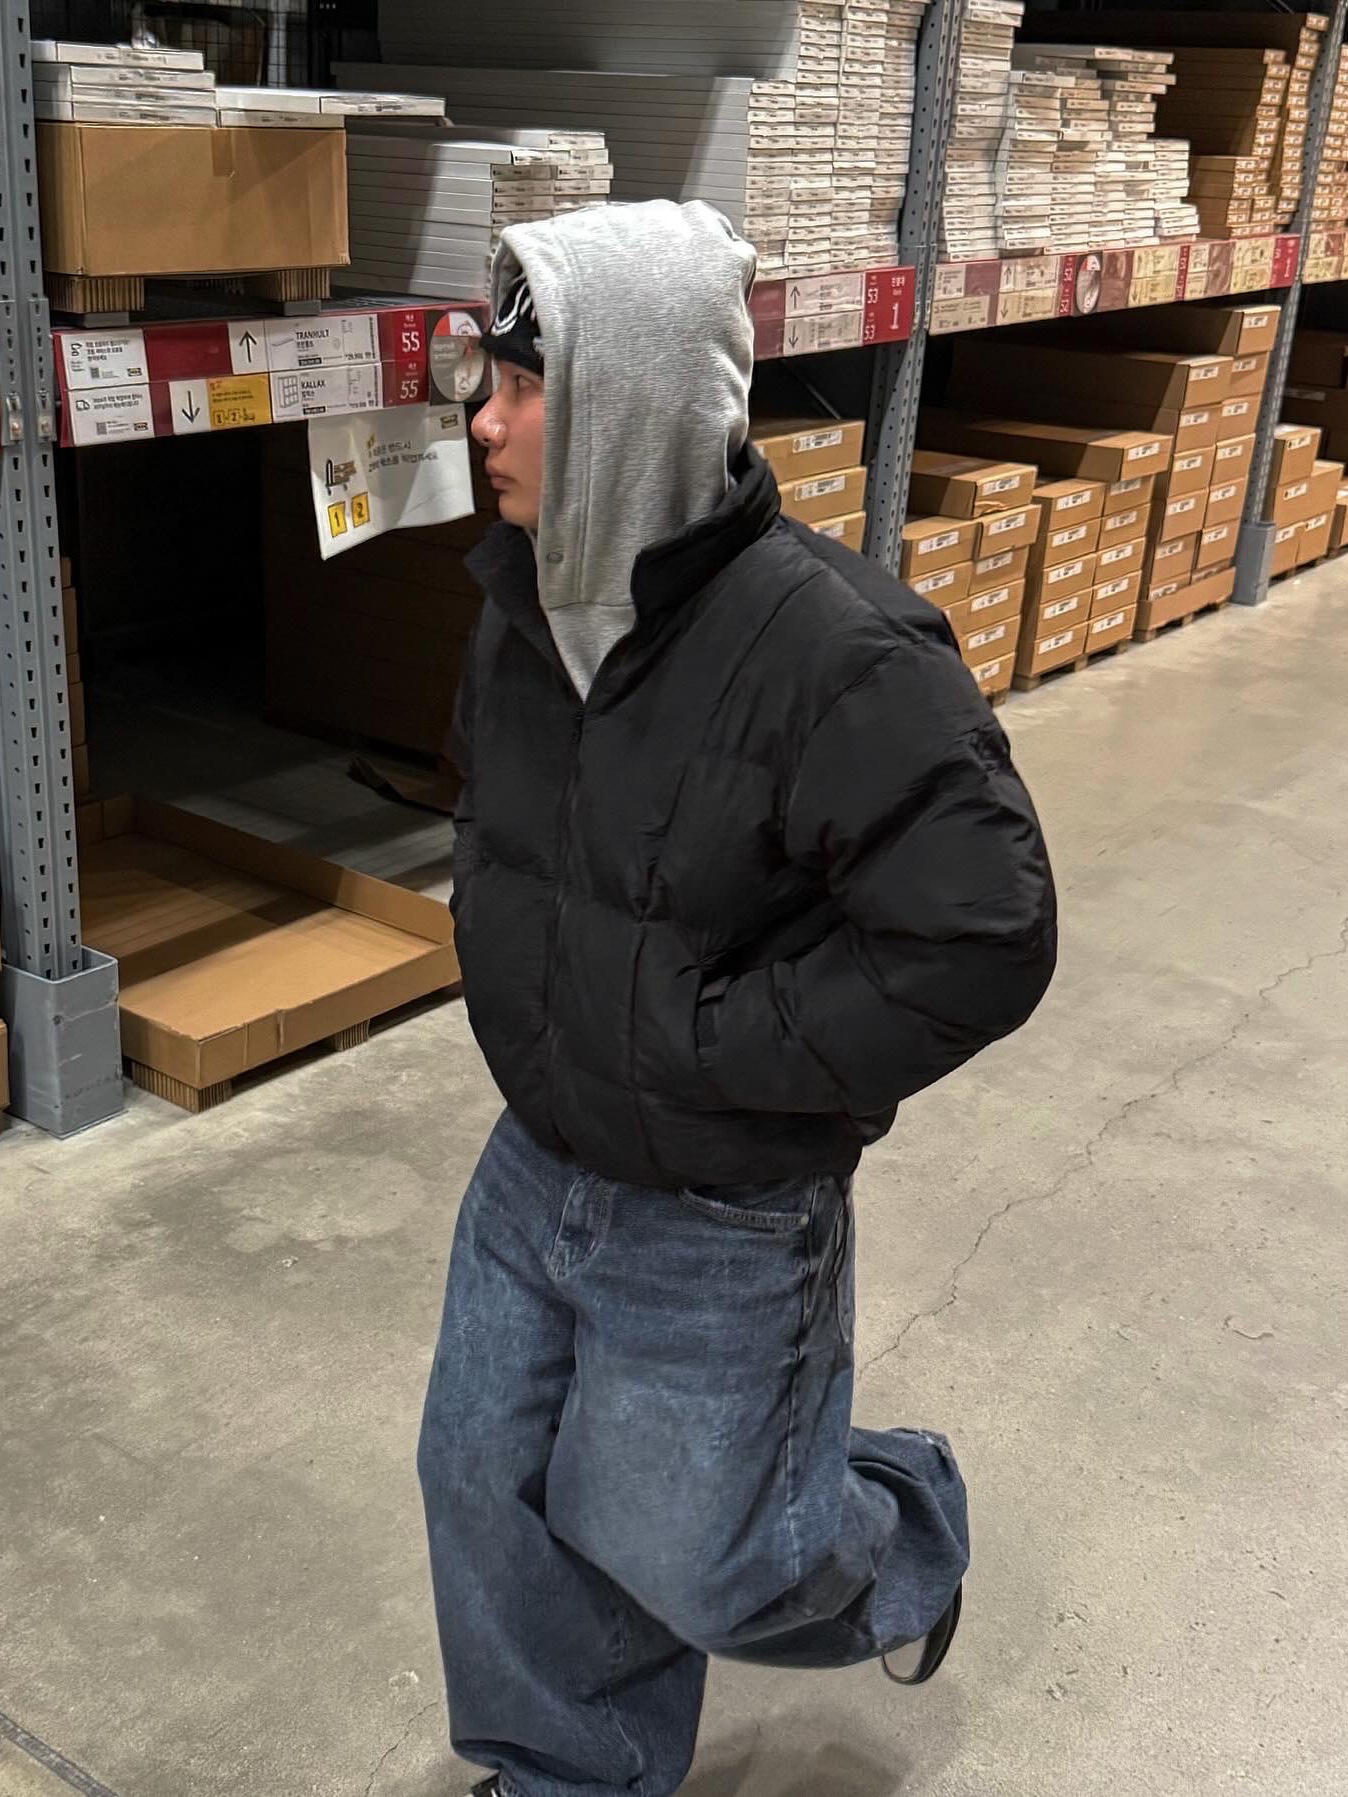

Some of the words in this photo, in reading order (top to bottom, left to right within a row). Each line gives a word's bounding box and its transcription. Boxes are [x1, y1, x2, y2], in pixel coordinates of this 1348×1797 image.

[867, 288, 879, 304] 53
[890, 302, 899, 330] 1
[296, 329, 330, 341] TRANHULT
[864, 324, 876, 340] 53
[401, 331, 420, 353] 55
[301, 380, 325, 389] KALLAX
[400, 379, 419, 399] 55
[356, 502, 364, 518] 2
